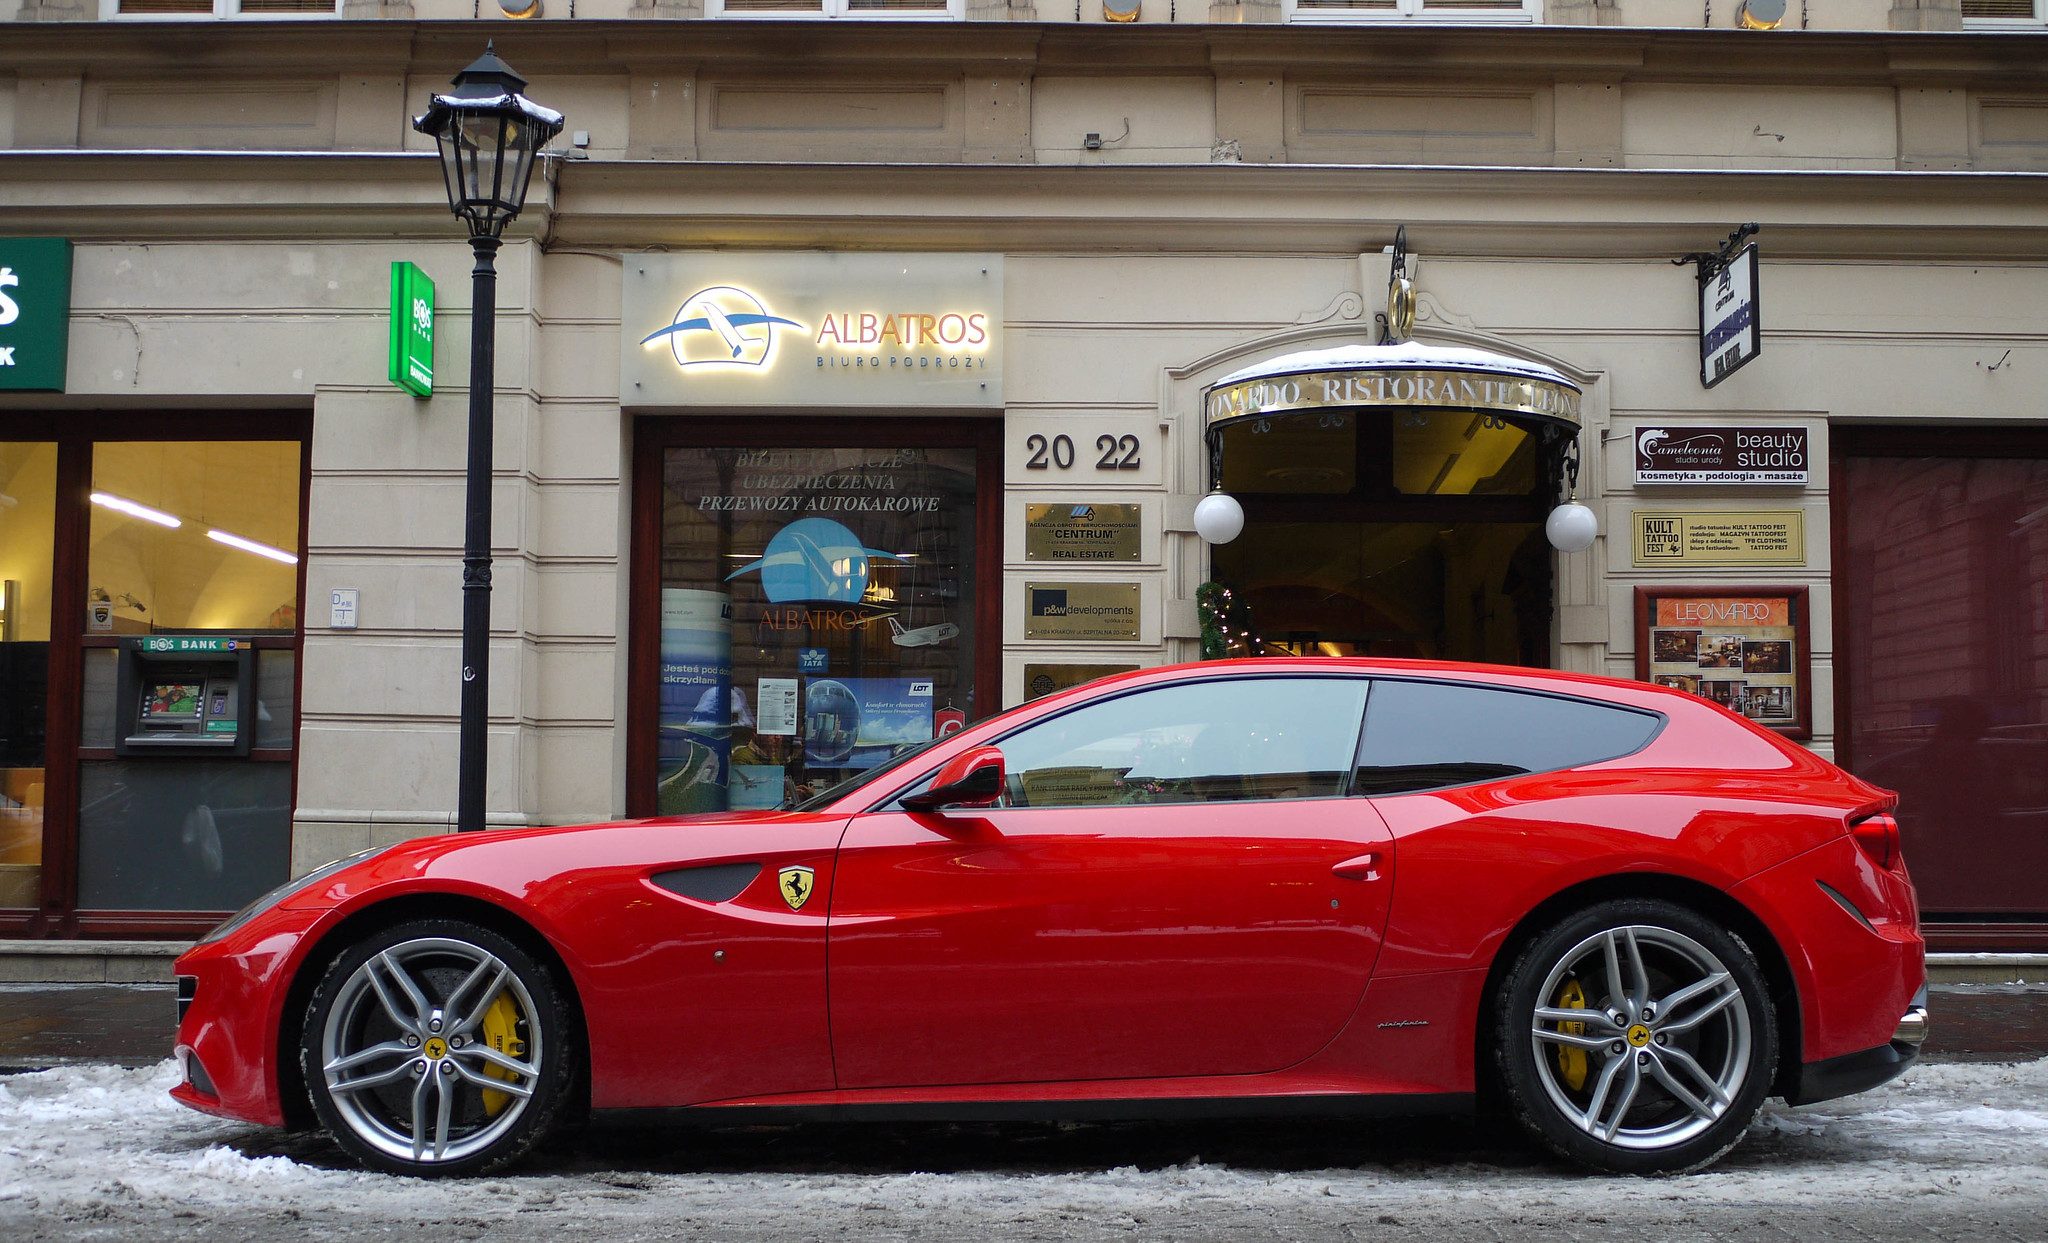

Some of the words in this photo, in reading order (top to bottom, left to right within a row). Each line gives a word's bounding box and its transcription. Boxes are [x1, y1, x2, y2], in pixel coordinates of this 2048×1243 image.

[816, 313, 986, 345] ALBATROS
[816, 356, 880, 368] BIURO
[889, 354, 986, 368] PODRÓŻY
[1321, 377, 1514, 405] RISTORANTE
[1646, 439, 1723, 456] Cameleonia
[1736, 431, 1803, 451] beauty
[1025, 433, 1075, 470] 20
[1095, 433, 1141, 470] 22
[1737, 448, 1803, 467] studio
[1675, 456, 1698, 464] studio
[1701, 456, 1723, 465] urody
[741, 474, 897, 490] UBEZPIECZENIA
[1640, 471, 1697, 481] kosmetyka
[1705, 471, 1756, 481] podologia
[1764, 471, 1804, 480] masaże
[697, 496, 803, 512] PRZEWOZY
[804, 496, 941, 513] AUTOKAROWE
[1645, 520, 1674, 534] KULT
[1646, 534, 1679, 543] TATTOO
[1052, 550, 1077, 559] REAL
[1080, 550, 1115, 559] ESTATE
[1646, 543, 1665, 553] FEST
[1067, 605, 1134, 616] developments
[1675, 602, 1770, 621] LEONARDO
[758, 609, 870, 630] ALBATROS
[938, 626, 950, 637] LOT
[150, 638, 174, 651] BOŚ
[181, 640, 217, 649] BANK
[663, 664, 700, 673] Jesteś
[701, 665, 718, 675] pod
[663, 675, 718, 685] skrzydłami
[912, 684, 930, 693] LOT
